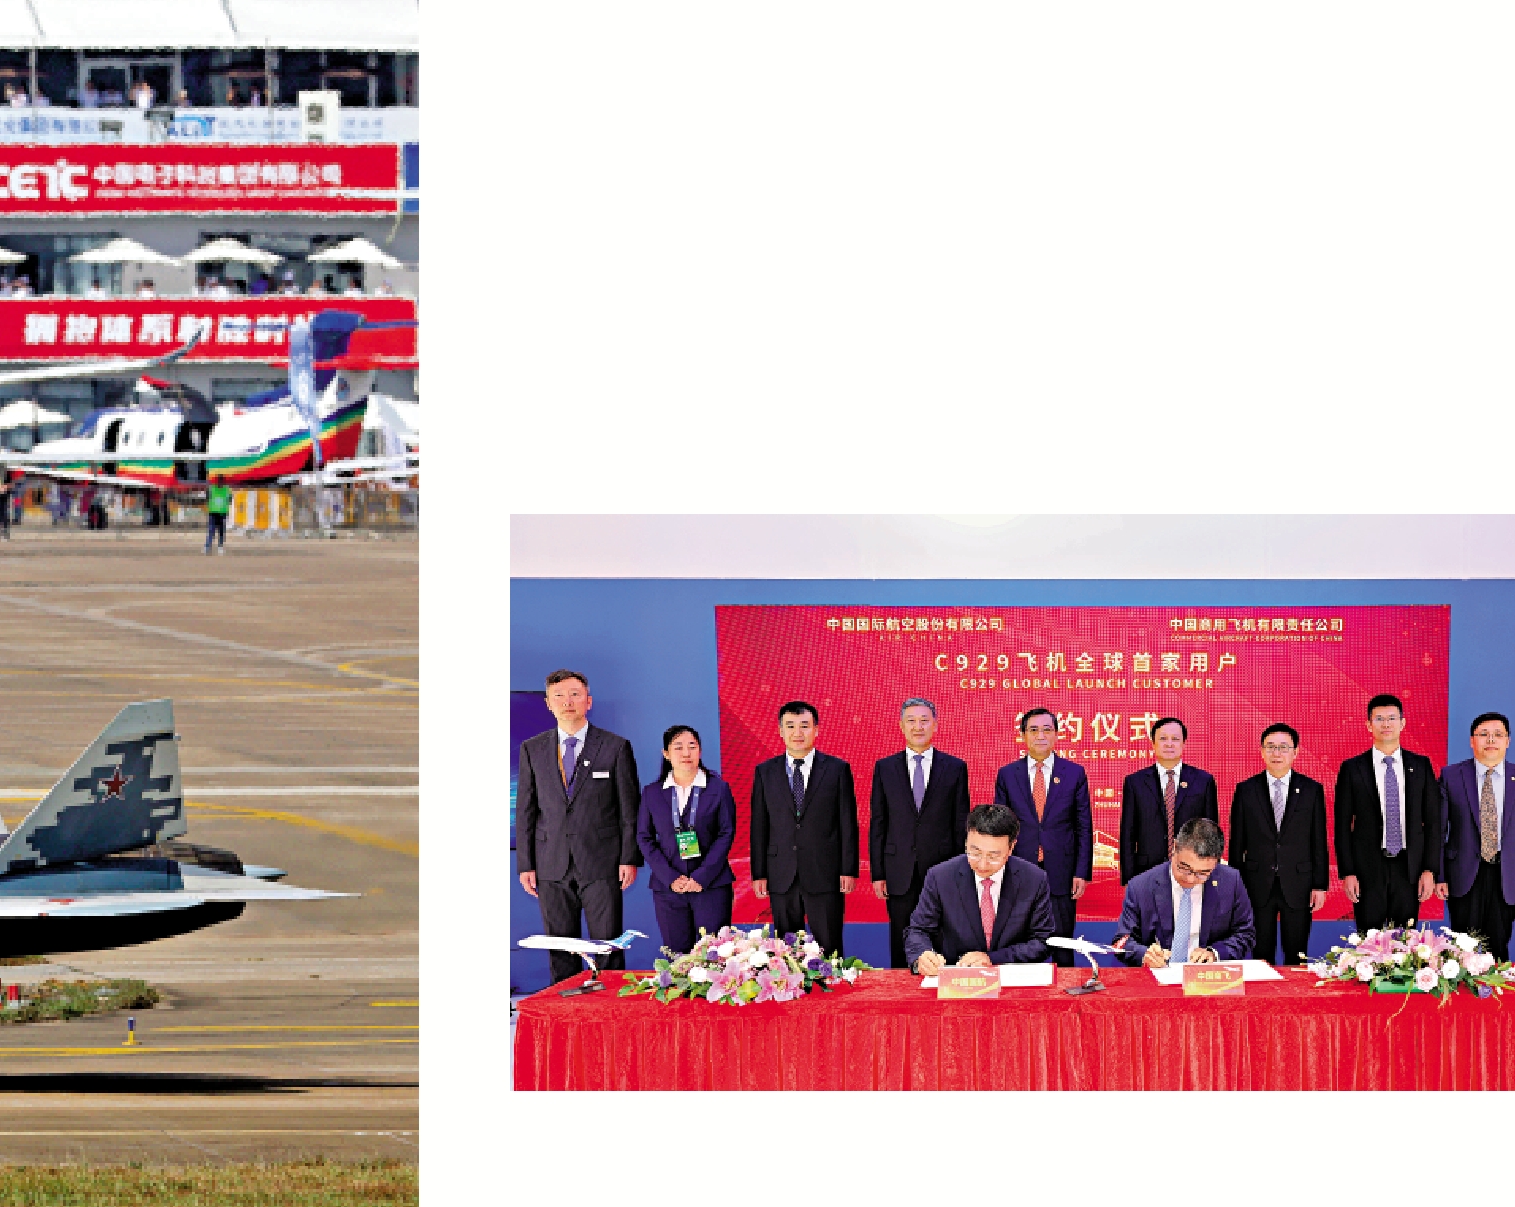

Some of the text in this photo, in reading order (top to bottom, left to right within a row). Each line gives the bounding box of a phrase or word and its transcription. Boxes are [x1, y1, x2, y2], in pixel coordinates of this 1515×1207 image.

[826, 616, 1004, 632] 中国国际航空股份有限公司
[1170, 616, 1344, 632] 中国商用飞机有限责任公司
[935, 651, 1237, 673] C929飞机全球首家用户
[959, 678, 1214, 690] C929 GLOBAL LAUNCH CUSTOMER
[1083, 749, 1155, 759] CEREMONY
